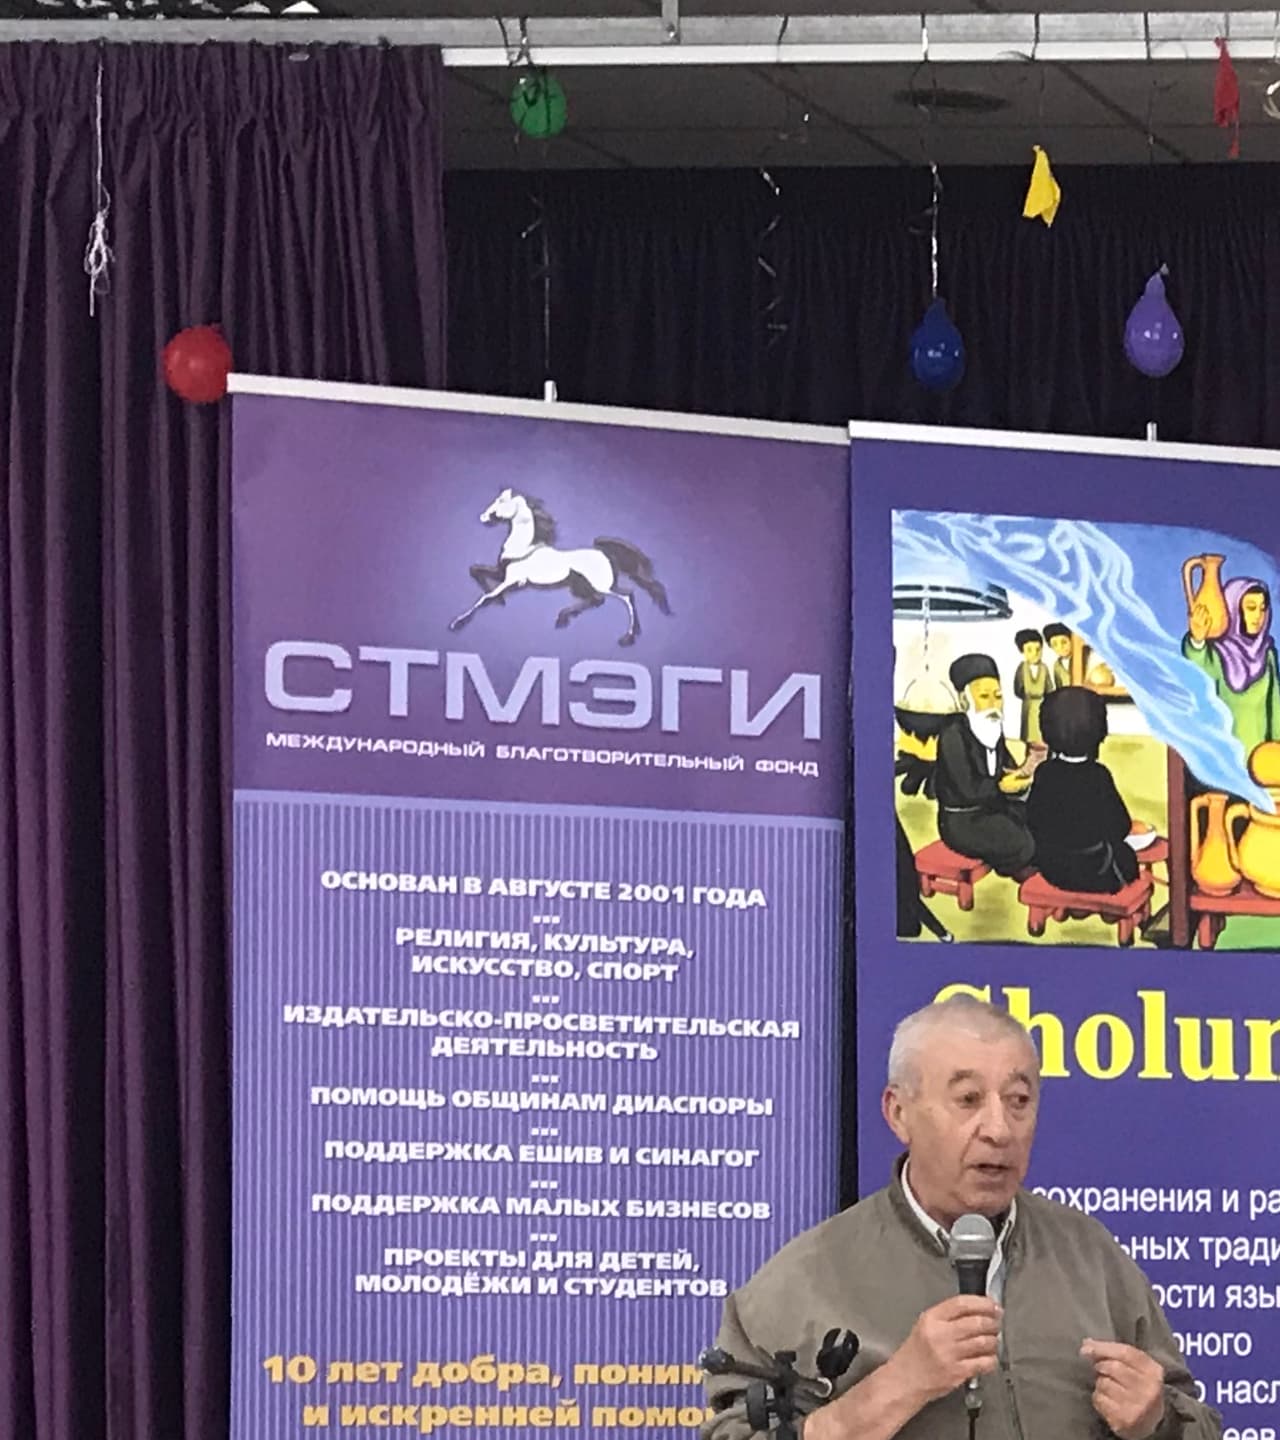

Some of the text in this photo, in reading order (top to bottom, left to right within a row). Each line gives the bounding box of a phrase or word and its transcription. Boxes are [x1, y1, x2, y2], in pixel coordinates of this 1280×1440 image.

[264, 640, 821, 740] СТМЭГИ
[266, 732, 819, 777] МЕЖДУНАРОДНЫЙ БЛАГОТВОРИТЕЛЬНЫЙ ФОНД
[321, 870, 767, 908] ОСНОВАН В АВГУСТЕ 2001 ГОДА
[396, 928, 695, 958] РЕЛИГИЯ, КУЛЬТУРА,
[412, 956, 678, 983] ИСКУССТВО, СПОРТ
[284, 1005, 800, 1039] ИЗДАТЕЛЬСКО-ПРОСВЕТИТЕЛЬСКАЯ
[431, 1037, 658, 1060] ДЕЯТЕЛЬНОСТЬ
[311, 1087, 773, 1117] ПОМОЩЬ ОБЩИНАМ ДИАСПОРЫ
[324, 1141, 759, 1168] ПОДДЕРЖКА ЕШИВ И СИНАГОГ
[312, 1194, 770, 1220] ПОДДЕРЖКА МАЛЫХ БИЗНЕСОВ
[1222, 1190, 1239, 1212] и
[384, 1248, 700, 1273] ПРОЕКТЫ ДЛЯ ДЕТЕЙ,
[1114, 1236, 1190, 1260] ных
[355, 1271, 728, 1299] МОЛОДЁЖИ И СТУДЕНТОВ
[1151, 1284, 1215, 1308] ости
[1172, 1332, 1252, 1356] ного
[263, 1355, 316, 1383] 10
[327, 1361, 402, 1384] лет
[412, 1354, 562, 1391] добра,
[303, 1400, 715, 1433] и искренней помо
